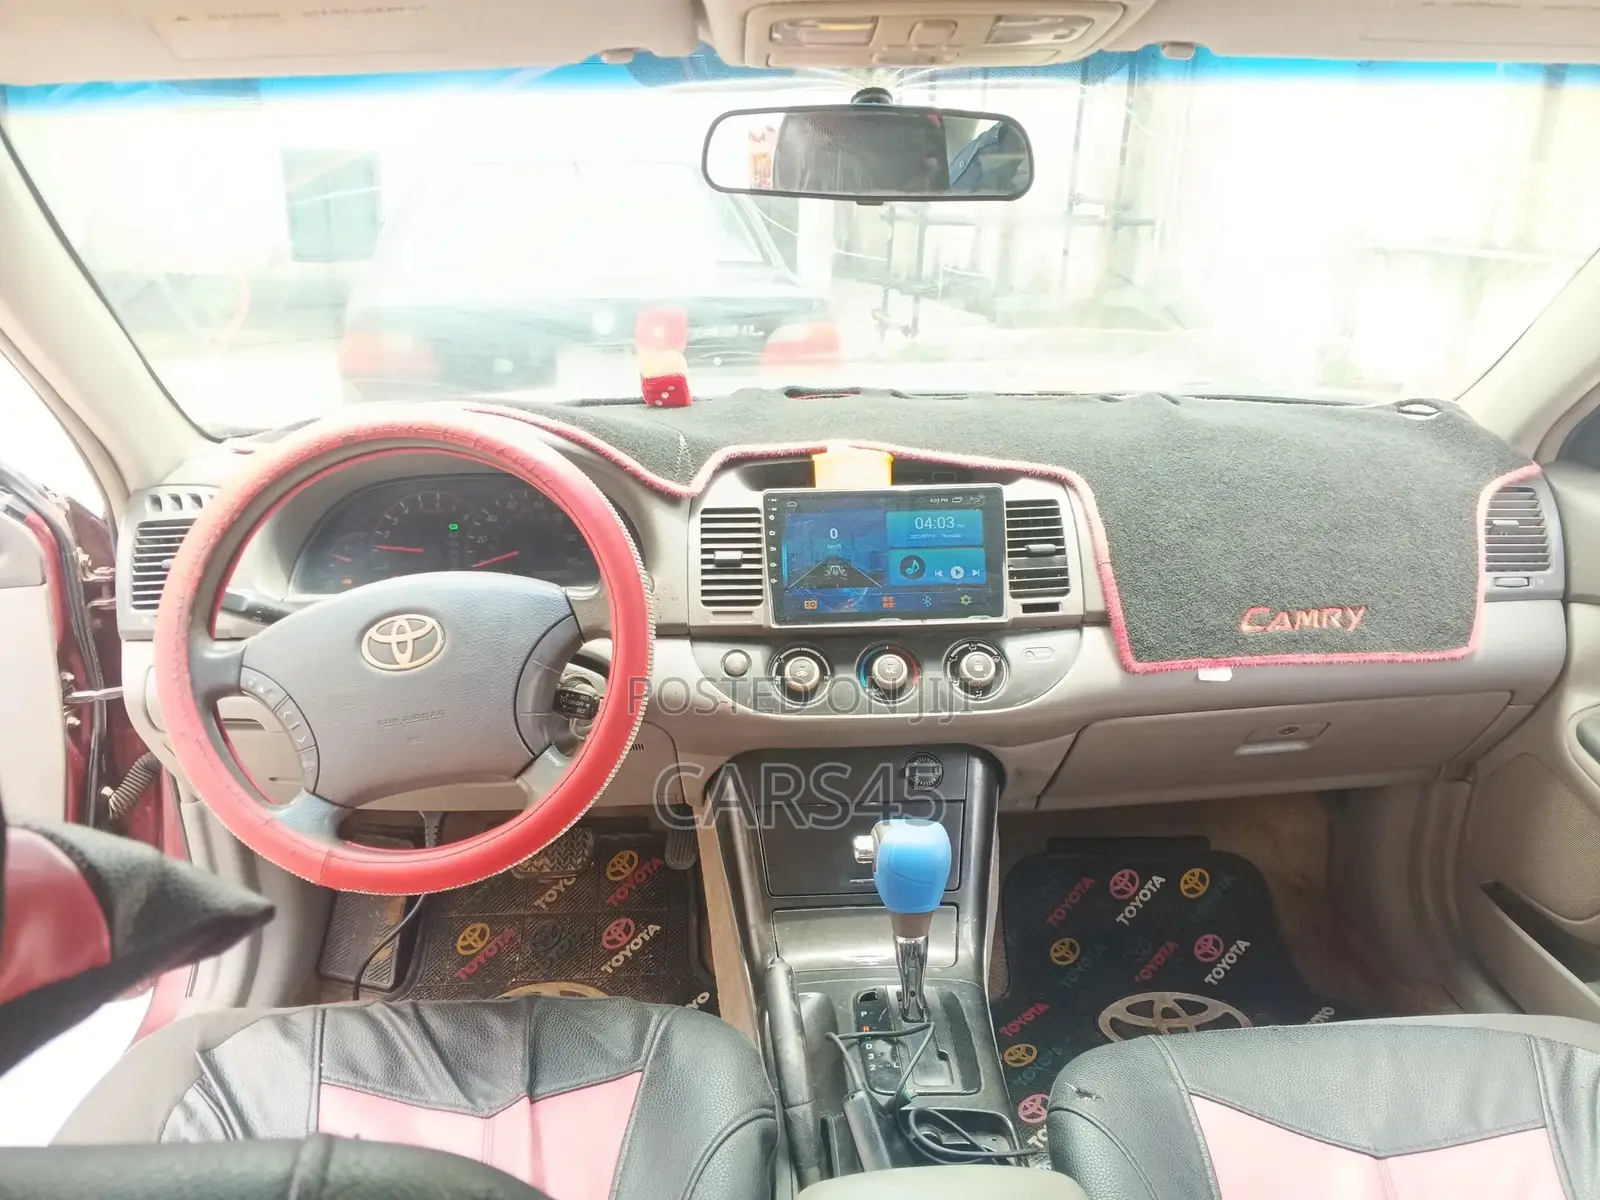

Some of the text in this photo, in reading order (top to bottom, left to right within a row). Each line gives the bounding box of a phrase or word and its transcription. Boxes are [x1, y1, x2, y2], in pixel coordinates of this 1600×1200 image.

[476, 535, 488, 543] 20
[829, 528, 838, 540] 0
[915, 516, 955, 530] 04:03
[1239, 605, 1367, 633] CAMRY
[608, 857, 664, 907] TOYOTA
[1046, 876, 1096, 928] TOYOTA
[1116, 874, 1167, 927] TOYOTA
[455, 928, 517, 980] TOYOTA
[600, 923, 662, 974] TOYOTA
[1204, 939, 1251, 987] TOYOTA
[1000, 1002, 1050, 1038] TOYOTA
